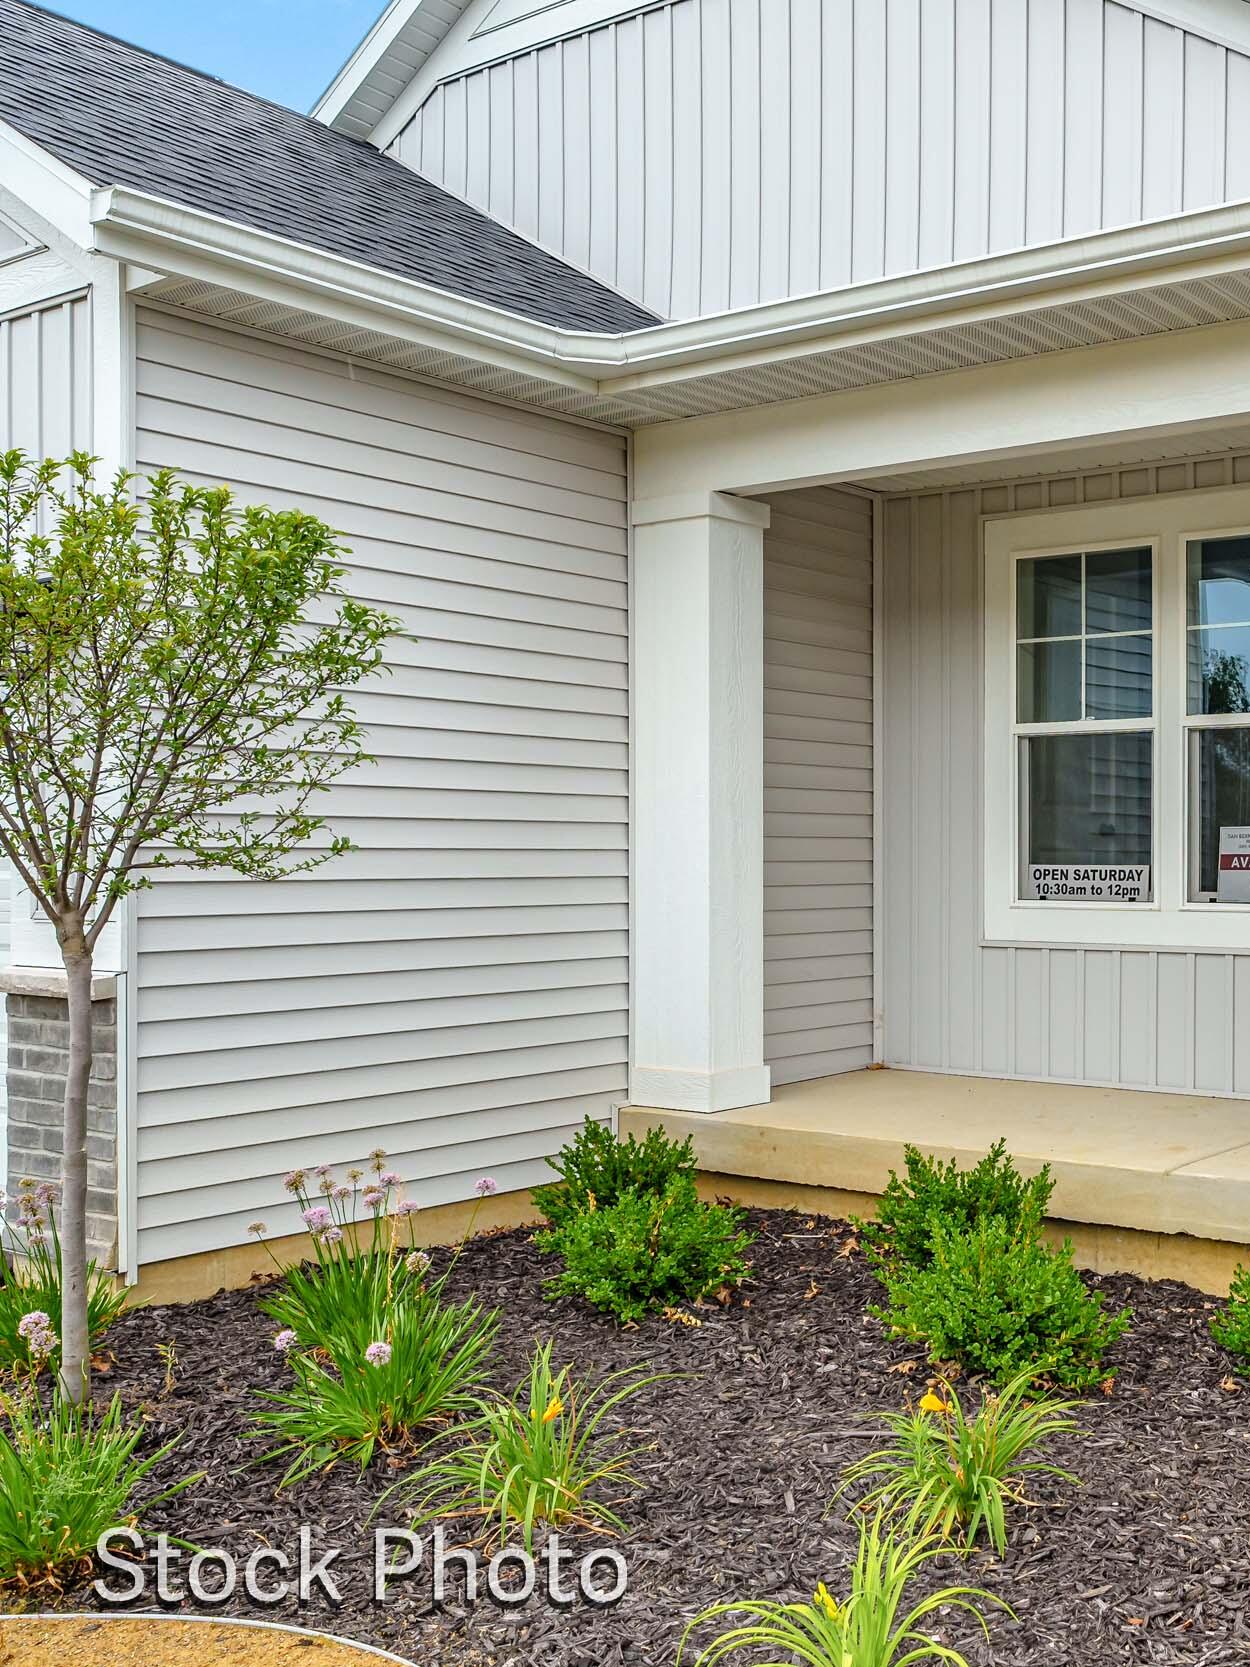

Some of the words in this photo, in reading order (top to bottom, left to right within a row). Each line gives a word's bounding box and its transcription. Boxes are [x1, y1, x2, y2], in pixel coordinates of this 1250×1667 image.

[1033, 868, 1069, 881] OPEN
[1073, 869, 1144, 882] SATURDAY
[1035, 883, 1087, 896] 10:30am
[1091, 884, 1103, 896] to
[1107, 884, 1140, 898] 12pm
